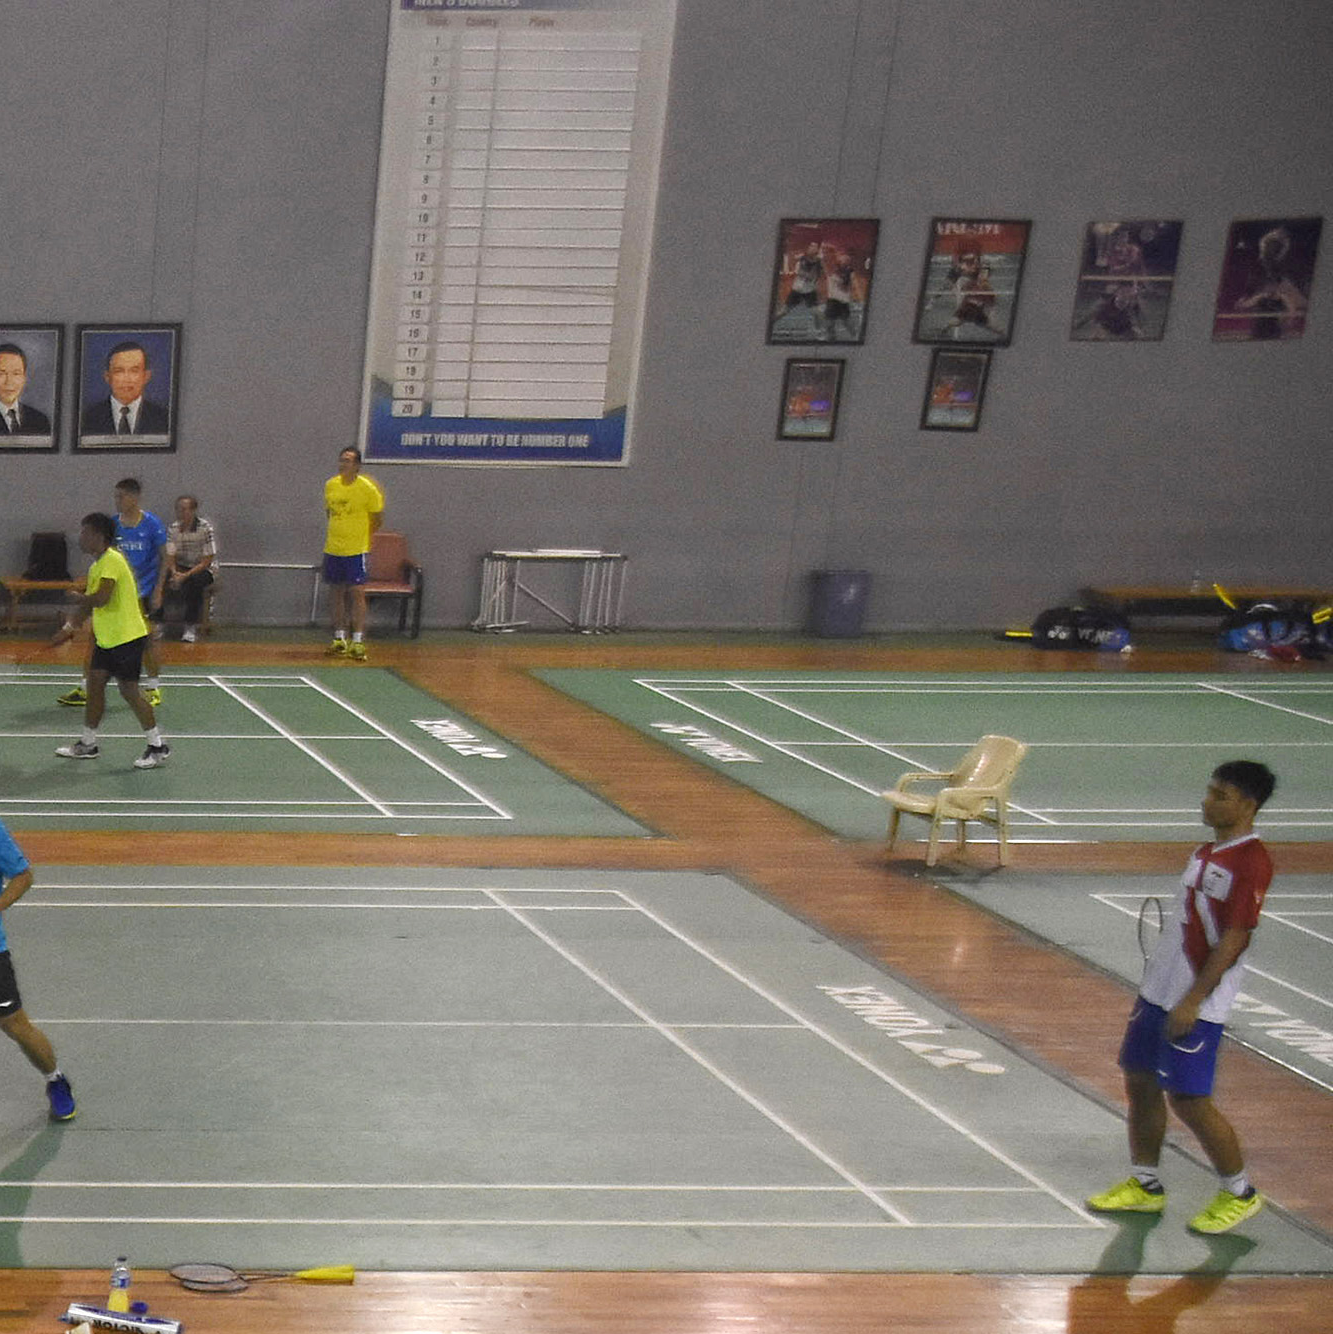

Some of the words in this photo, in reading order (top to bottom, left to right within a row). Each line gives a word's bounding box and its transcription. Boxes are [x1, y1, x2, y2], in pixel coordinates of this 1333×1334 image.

[418, 212, 429, 223] 10
[416, 232, 426, 243] 11
[414, 252, 425, 262] 12
[413, 271, 424, 281] 13
[412, 290, 422, 300] 14
[410, 309, 421, 319] 15
[408, 329, 419, 339] 16
[407, 347, 418, 358] 17
[405, 366, 416, 377] 18
[404, 385, 415, 395] 19
[402, 404, 413, 414] 20
[401, 433, 431, 447] DON'T
[434, 434, 456, 447] YOU
[457, 434, 490, 447] WANT
[491, 434, 505, 447] TO
[522, 434, 566, 448] NUMBER
[568, 434, 589, 448] ONE
[815, 985, 944, 1038] YONEX
